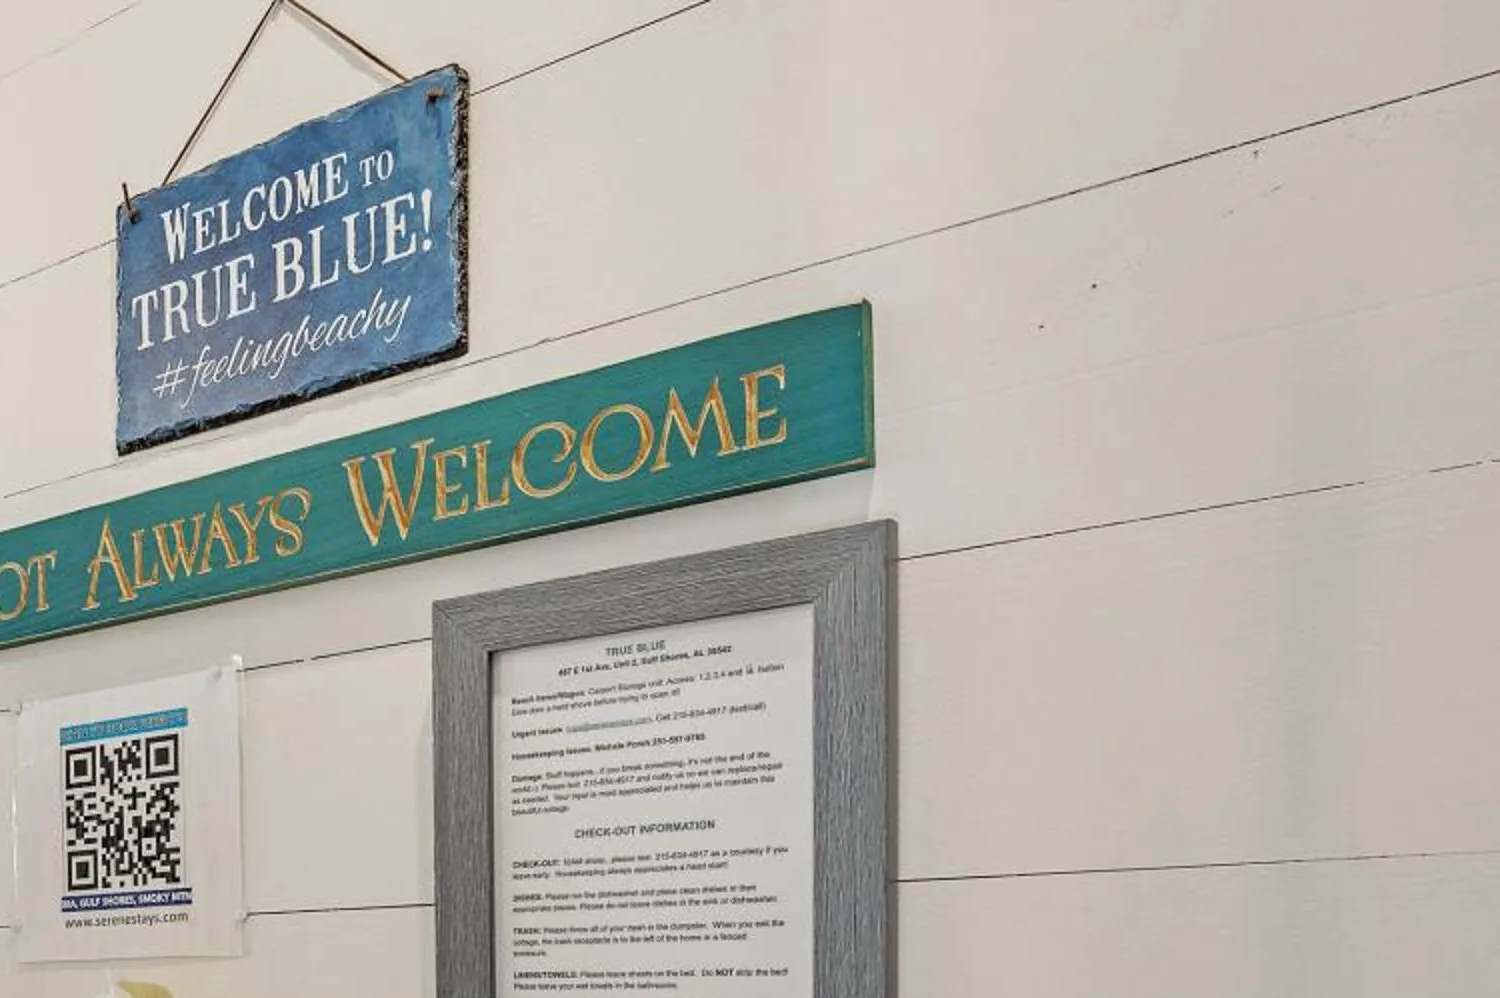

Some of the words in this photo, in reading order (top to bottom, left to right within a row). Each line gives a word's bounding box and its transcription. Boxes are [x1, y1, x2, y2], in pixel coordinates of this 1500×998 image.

[160, 152, 349, 265] WELCOME
[358, 149, 395, 187] TO
[130, 253, 257, 352] TRUE
[271, 187, 434, 304] BLUE!
[152, 287, 413, 408] #feelingbeachy
[85, 486, 312, 610] ALWAYS
[341, 363, 788, 548] WELCOME
[606, 643, 633, 656] TRUE
[574, 824, 636, 839] CHECK-OUT
[639, 819, 715, 835] INFORMATION
[65, 911, 188, 929] www.serenestays.com
[715, 967, 734, 977] NOT
